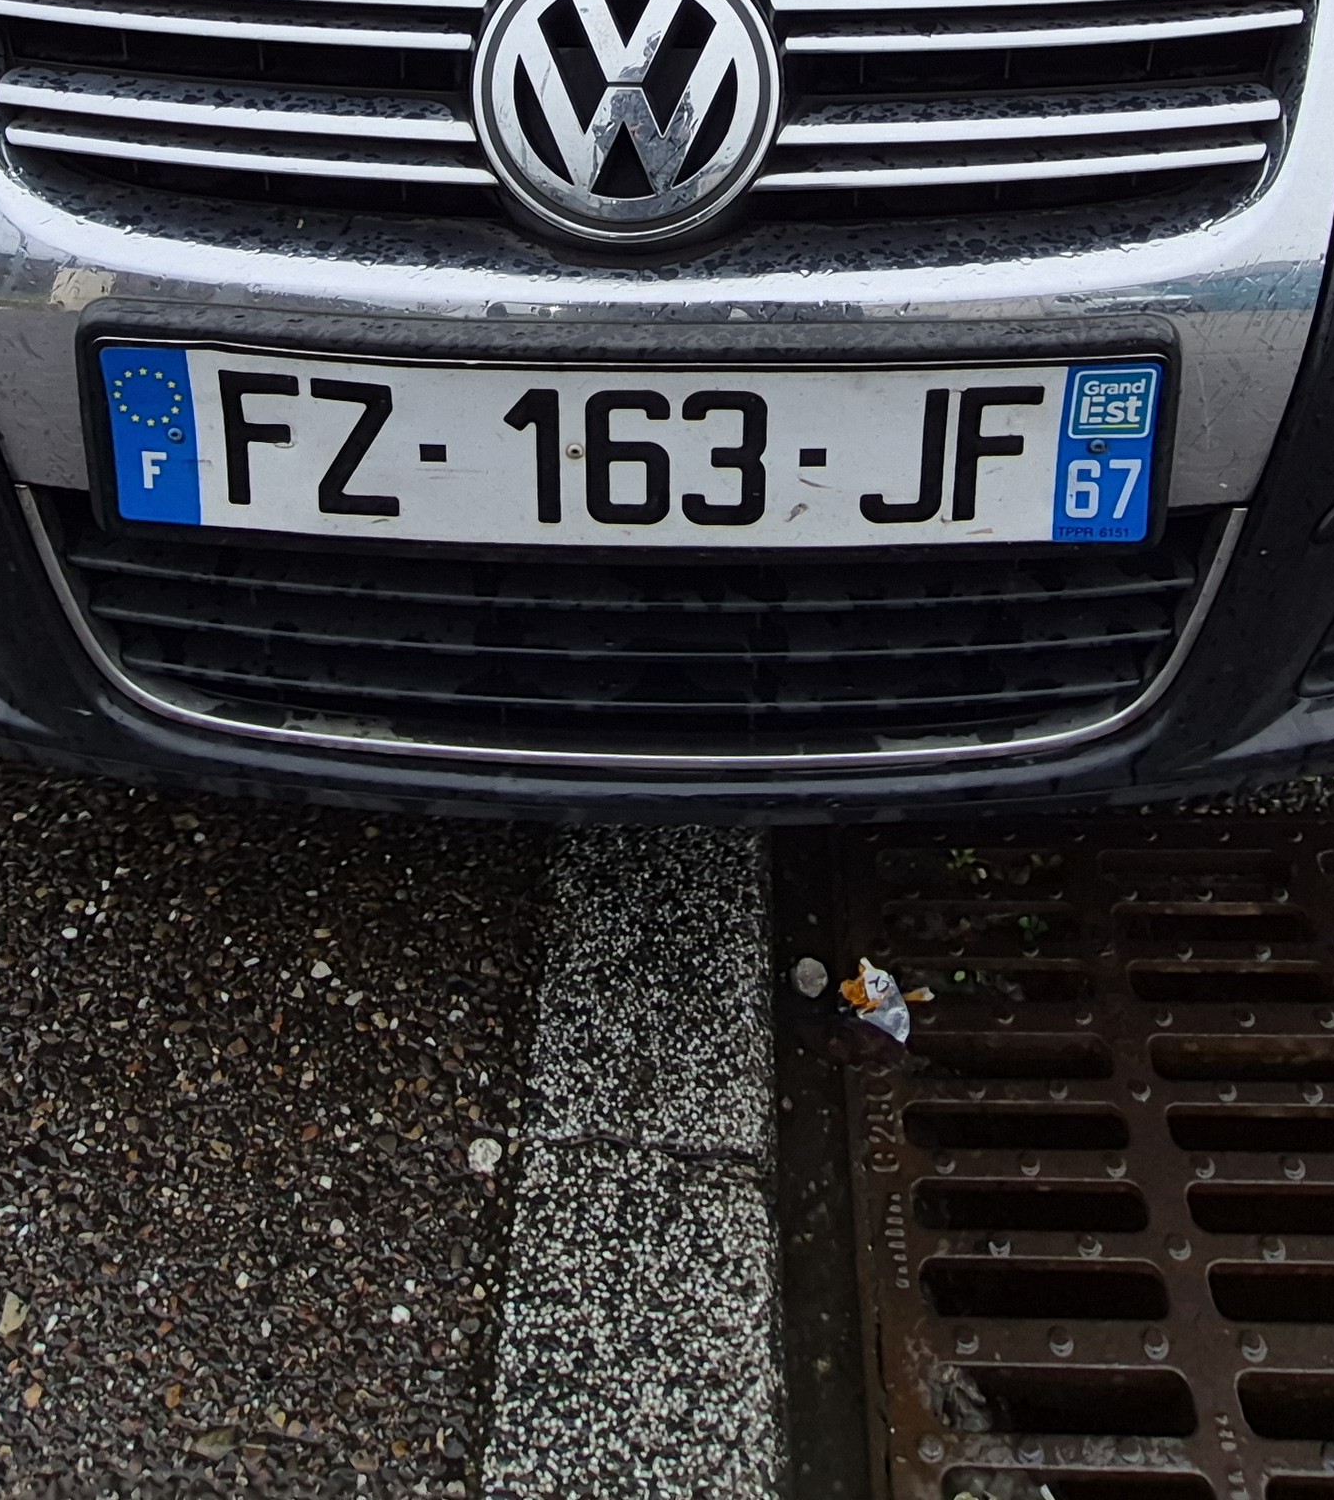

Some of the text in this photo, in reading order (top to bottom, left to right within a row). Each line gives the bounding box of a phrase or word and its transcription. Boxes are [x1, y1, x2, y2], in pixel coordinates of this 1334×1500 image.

[1083, 378, 1147, 396] Grand
[1079, 395, 1143, 424] Est
[141, 450, 167, 490] F
[1064, 458, 1142, 520] 67
[1058, 526, 1130, 538] TPPR 6151
